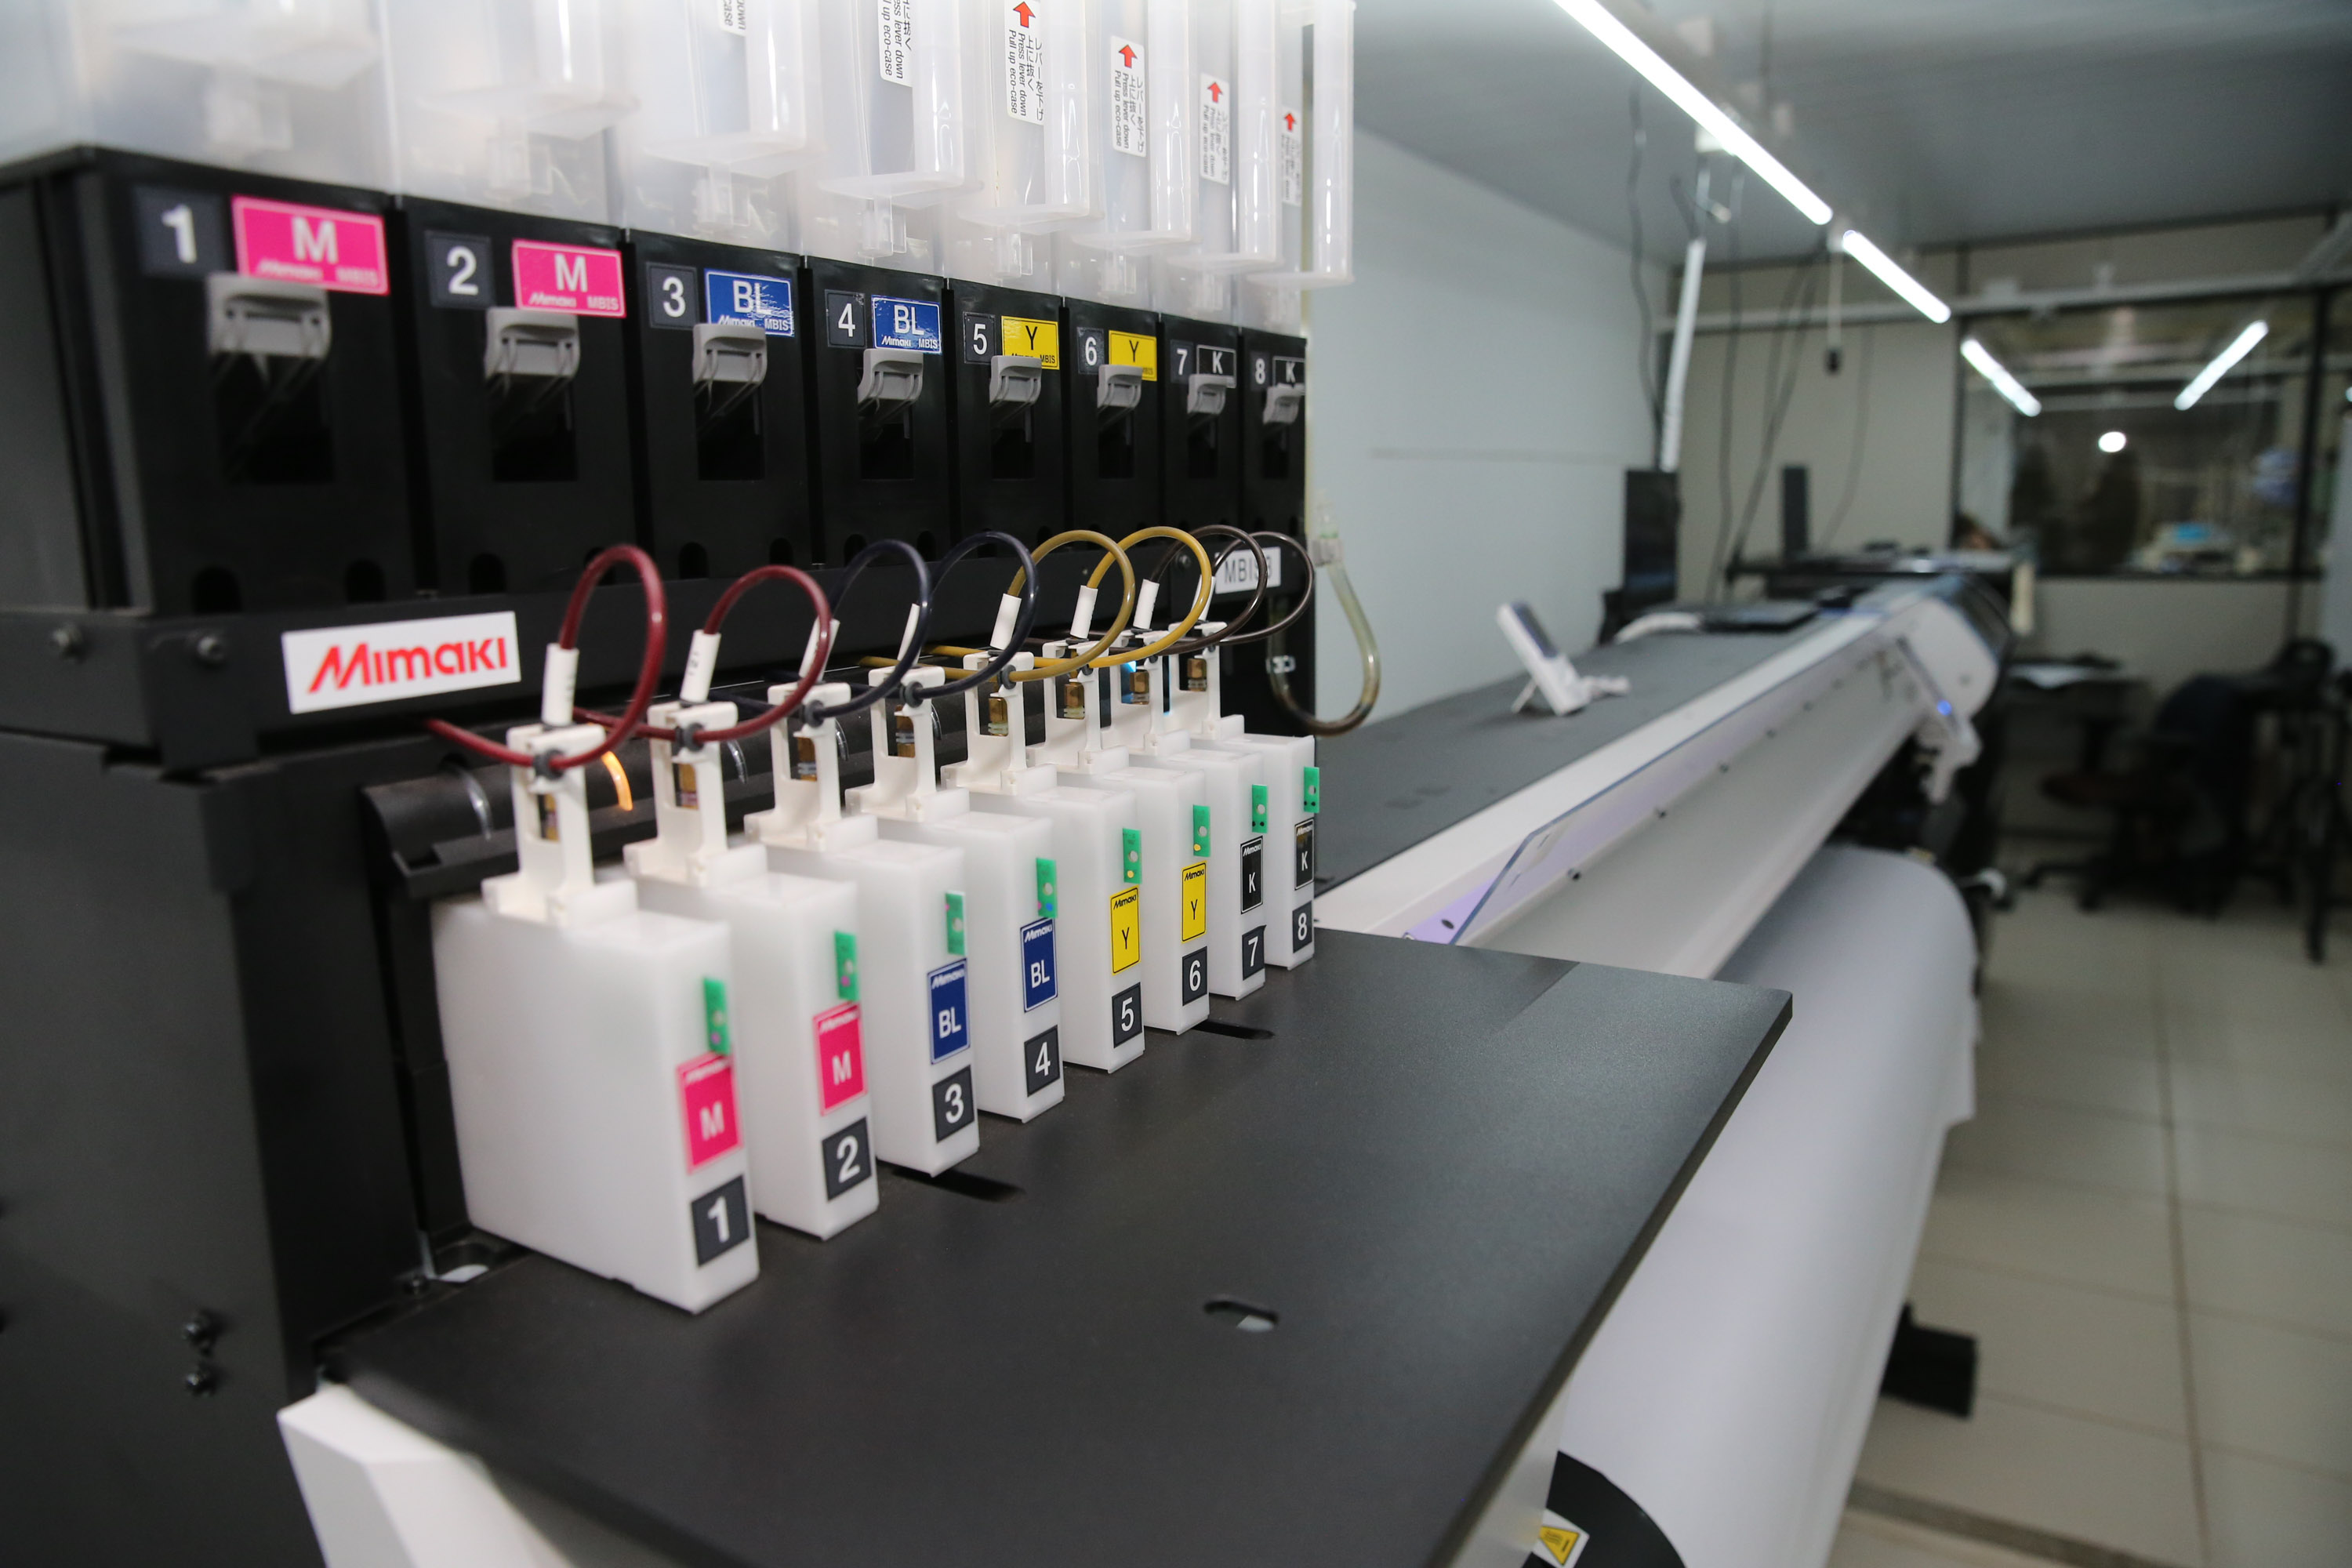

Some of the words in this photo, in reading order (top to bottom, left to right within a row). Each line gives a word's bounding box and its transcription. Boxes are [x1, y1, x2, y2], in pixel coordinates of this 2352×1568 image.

[881, 6, 891, 21] up
[895, 20, 903, 47] lever
[884, 25, 892, 76] eco-case
[895, 49, 904, 78] down
[1008, 51, 1016, 64] up
[1114, 90, 1121, 102] up
[162, 204, 197, 263] 1
[291, 216, 339, 264] M
[447, 246, 479, 296] 2
[554, 253, 588, 292] M
[587, 296, 619, 310] MBIS
[662, 276, 686, 318] 3
[733, 281, 773, 315] BL
[764, 318, 789, 331] MBIS
[838, 303, 855, 337] 4
[894, 304, 924, 336] BL
[881, 336, 911, 347] Mimaki
[918, 338, 938, 349] MBIS
[973, 323, 987, 355] 5
[1025, 325, 1038, 350] Y
[1085, 336, 1098, 366] 6
[1129, 339, 1139, 362] Y
[1177, 348, 1188, 376] 7
[1212, 350, 1223, 374] K
[1255, 358, 1265, 384] 8
[1286, 361, 1296, 383] K
[308, 637, 508, 694] Mimaki
[1184, 869, 1205, 881] Mimaki
[1301, 851, 1308, 871] K
[1249, 872, 1256, 894] K
[1113, 894, 1137, 909] Mimaki
[1191, 898, 1198, 920] Y
[1024, 924, 1053, 943] Mimaki
[1122, 927, 1130, 949] Y
[1298, 912, 1308, 941] 8
[1248, 936, 1258, 967] 7
[1031, 960, 1051, 989] BL
[1189, 960, 1201, 992] 6
[938, 1007, 962, 1039] BL
[1121, 996, 1134, 1032] 5
[832, 1050, 852, 1085] M
[1035, 1041, 1051, 1076] 4
[945, 1083, 964, 1123] 3
[699, 1100, 725, 1141] M
[837, 1135, 860, 1183] 2
[708, 1196, 730, 1243] 1
